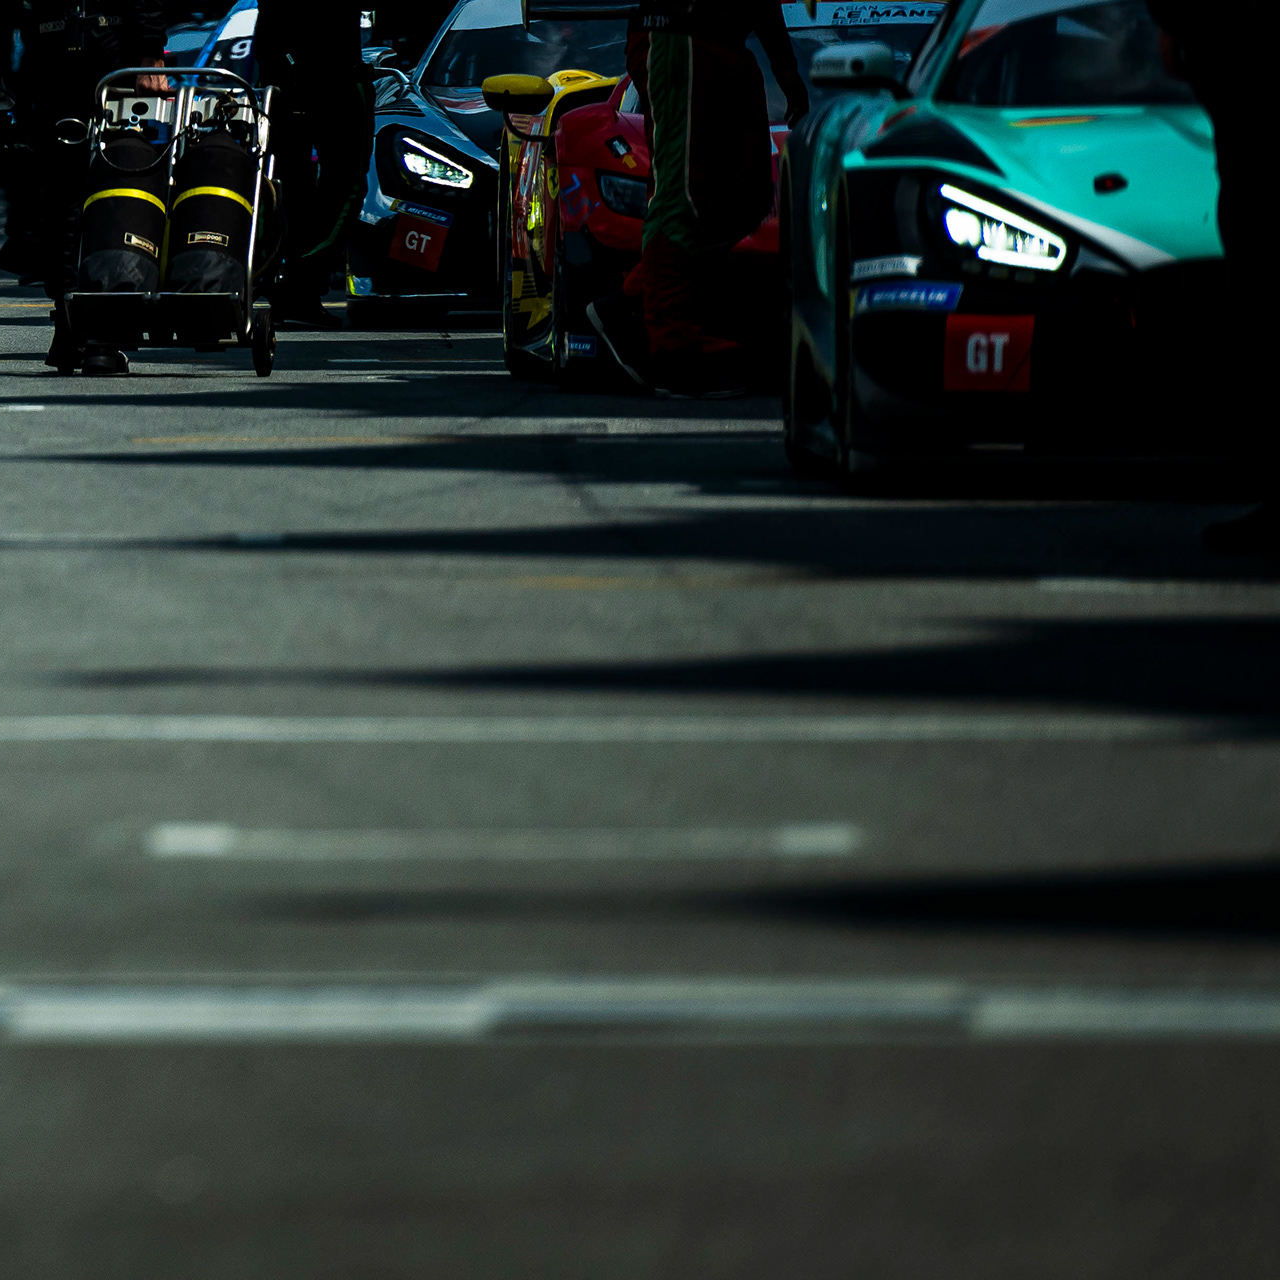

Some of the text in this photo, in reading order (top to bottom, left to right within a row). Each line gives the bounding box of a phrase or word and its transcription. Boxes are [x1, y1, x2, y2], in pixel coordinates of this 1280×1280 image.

[833, 9, 942, 19] LE MANS
[407, 207, 448, 222] MICHELIN
[405, 230, 432, 255] GT
[966, 331, 1010, 375] GT
